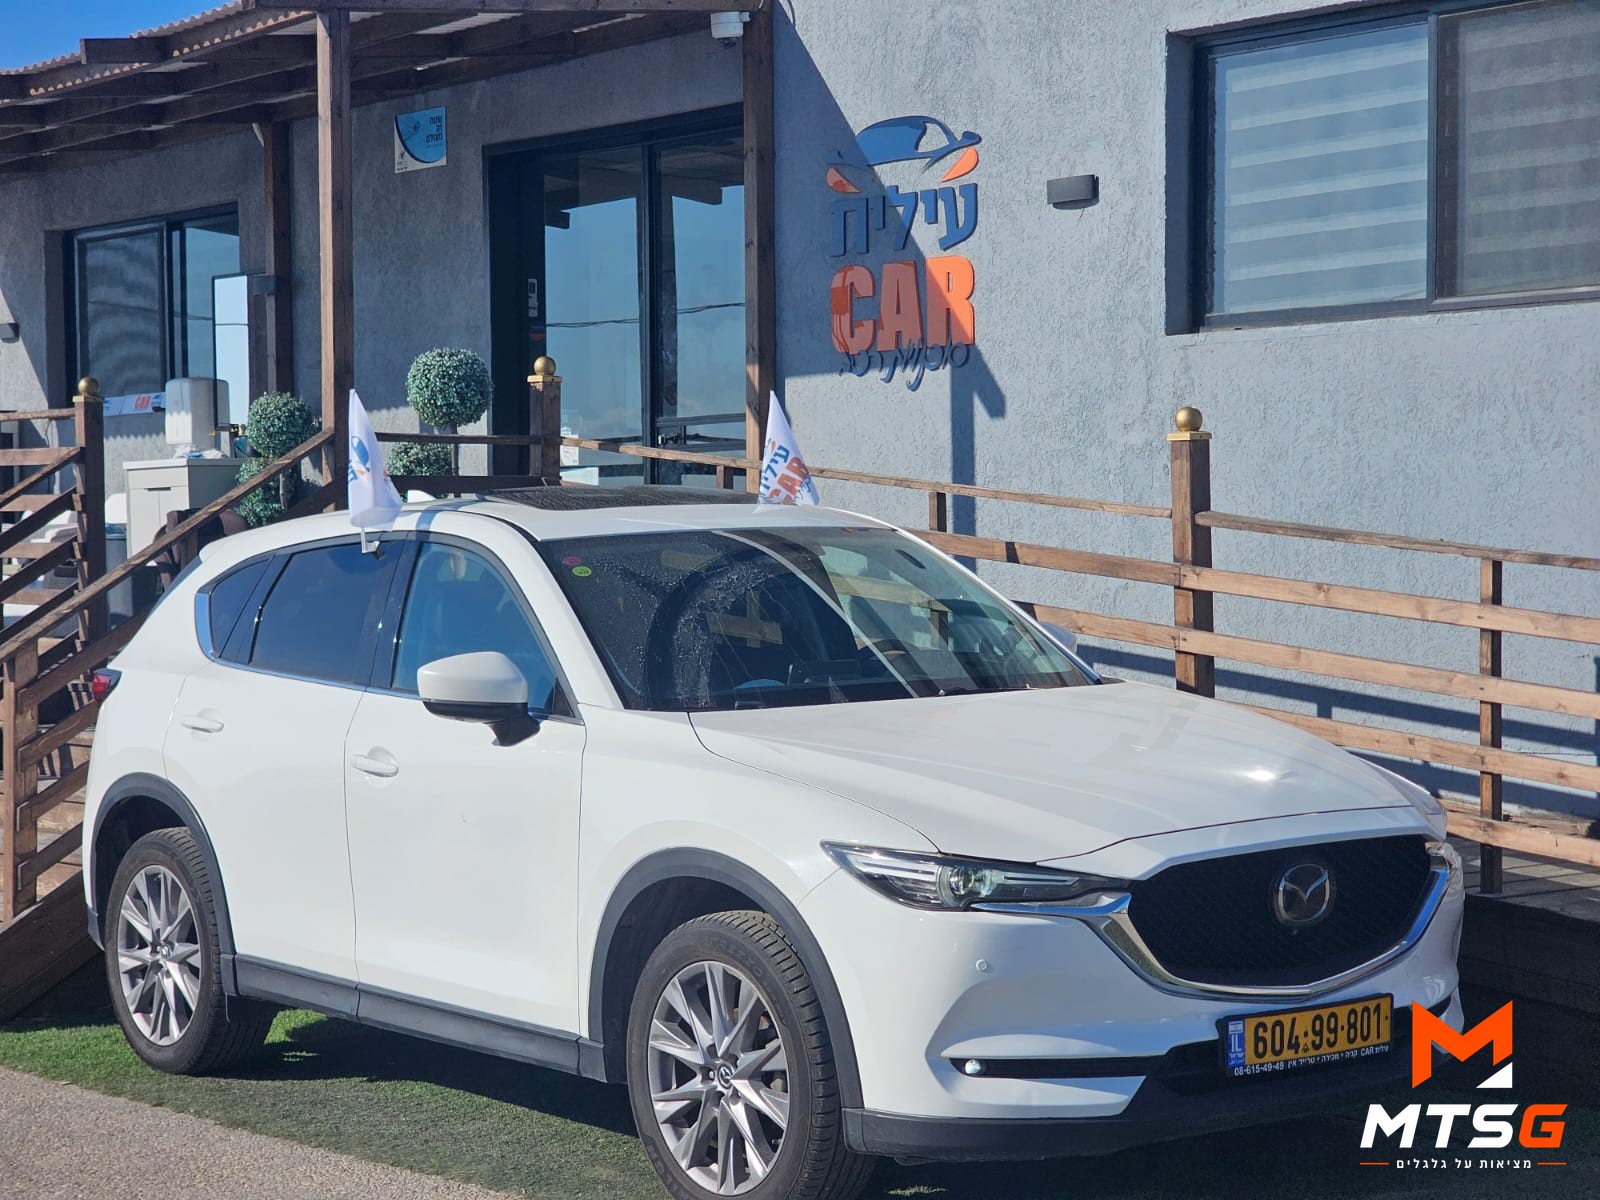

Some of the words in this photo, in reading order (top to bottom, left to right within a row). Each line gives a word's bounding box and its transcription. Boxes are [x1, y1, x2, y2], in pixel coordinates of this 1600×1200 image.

[830, 183, 978, 257] עילית
[830, 255, 976, 355] CAR
[1231, 1034, 1242, 1053] IL
[1360, 1046, 1375, 1057] CAR
[1233, 1061, 1285, 1077] 08-615-49-49
